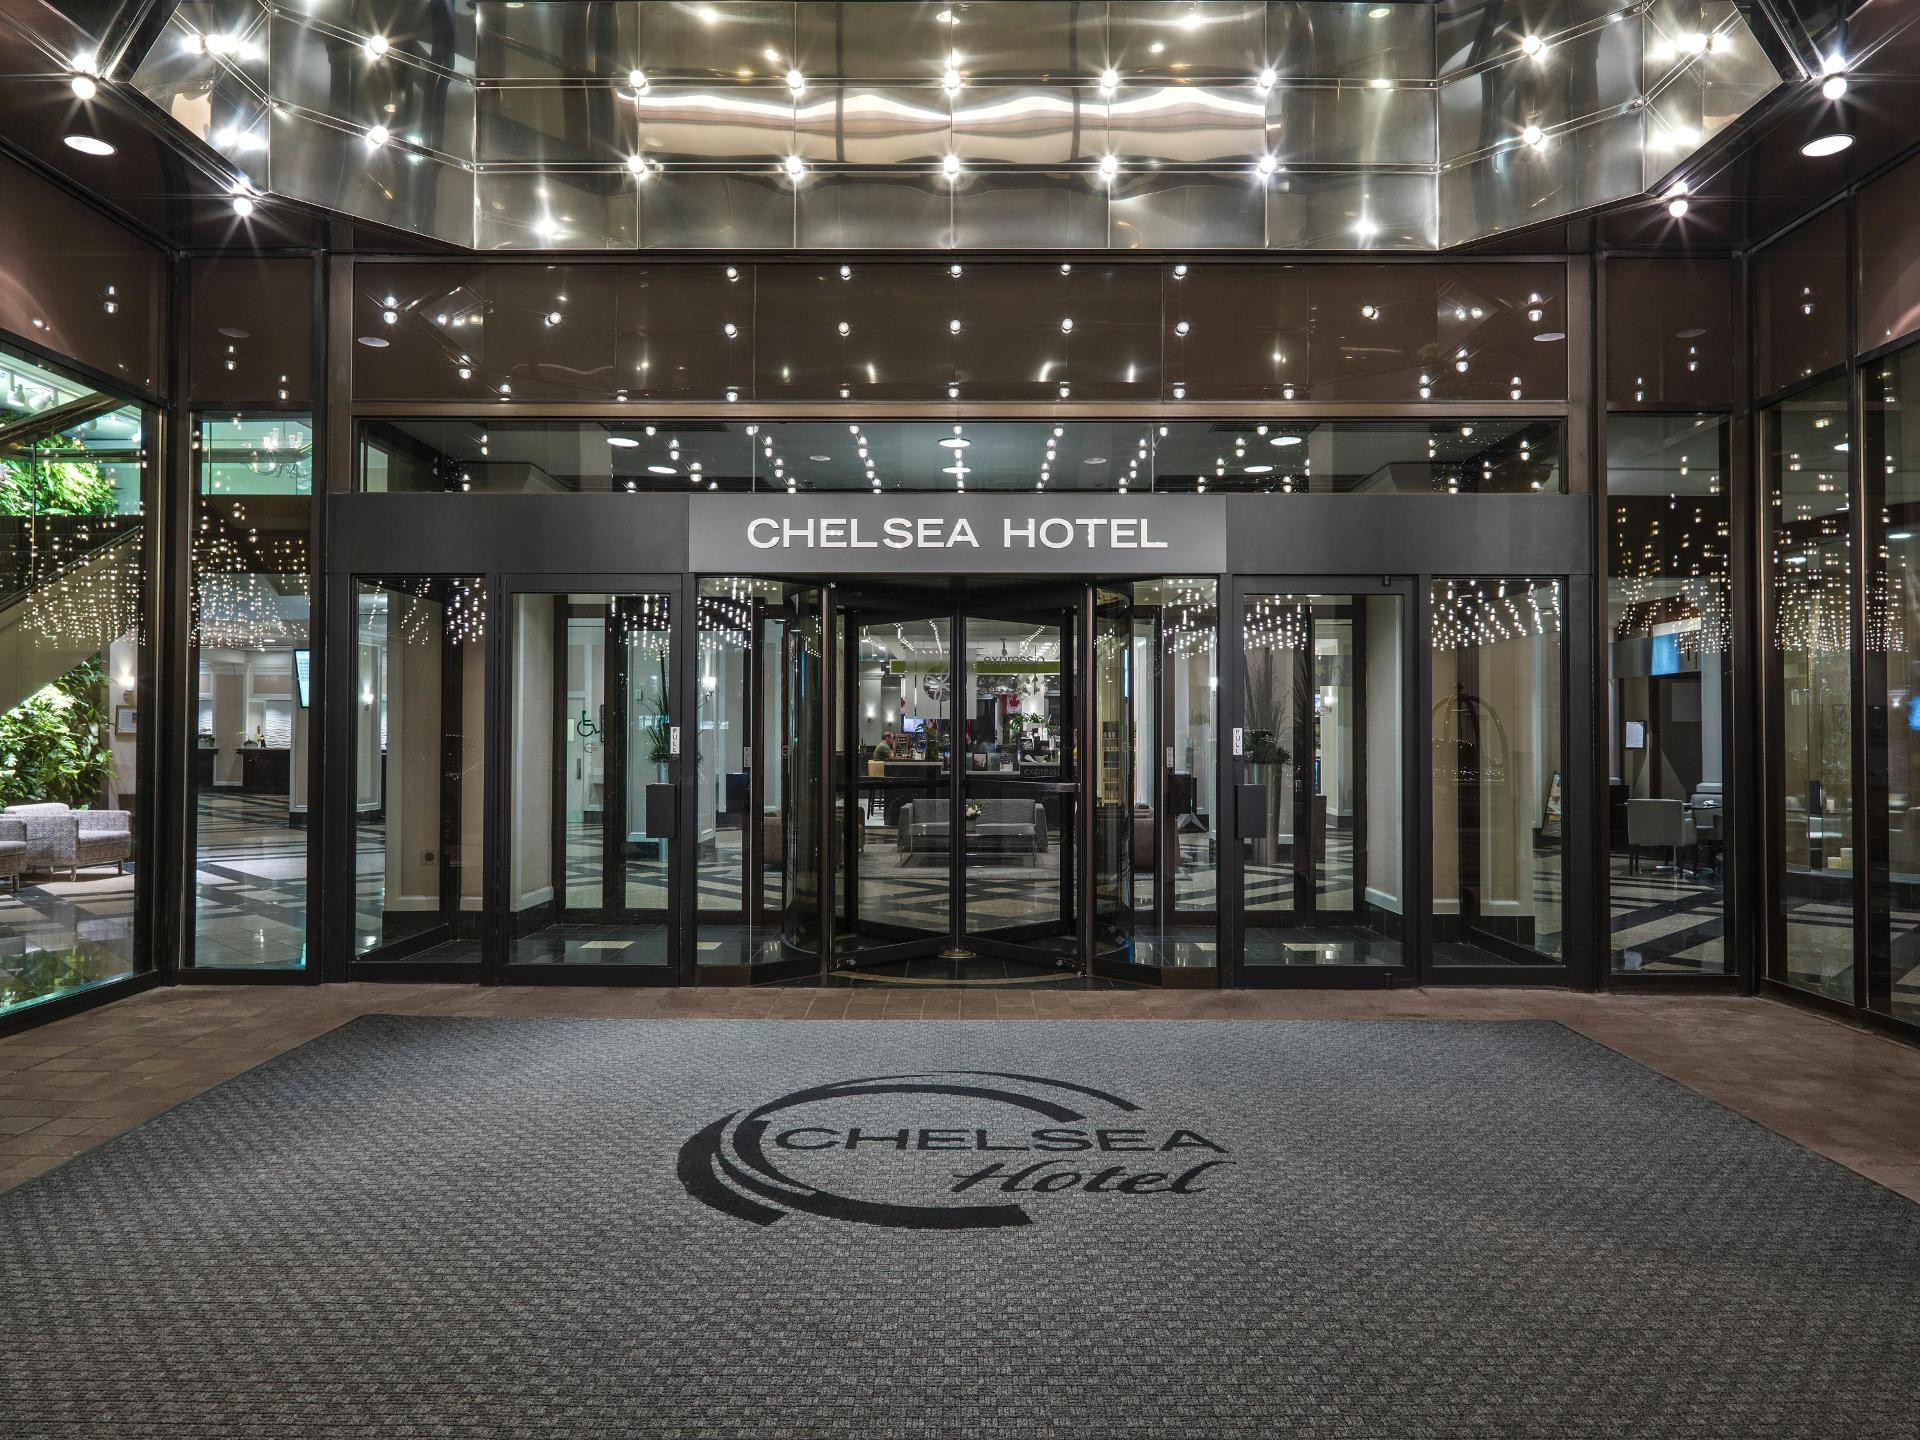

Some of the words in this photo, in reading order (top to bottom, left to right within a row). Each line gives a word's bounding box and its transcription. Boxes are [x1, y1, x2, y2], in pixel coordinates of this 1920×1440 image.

[747, 517, 980, 549] CHELSEA
[1003, 518, 1168, 549] HOTEL
[776, 1127, 1229, 1154] CHELSEA
[951, 1160, 1238, 1195] Hotel
